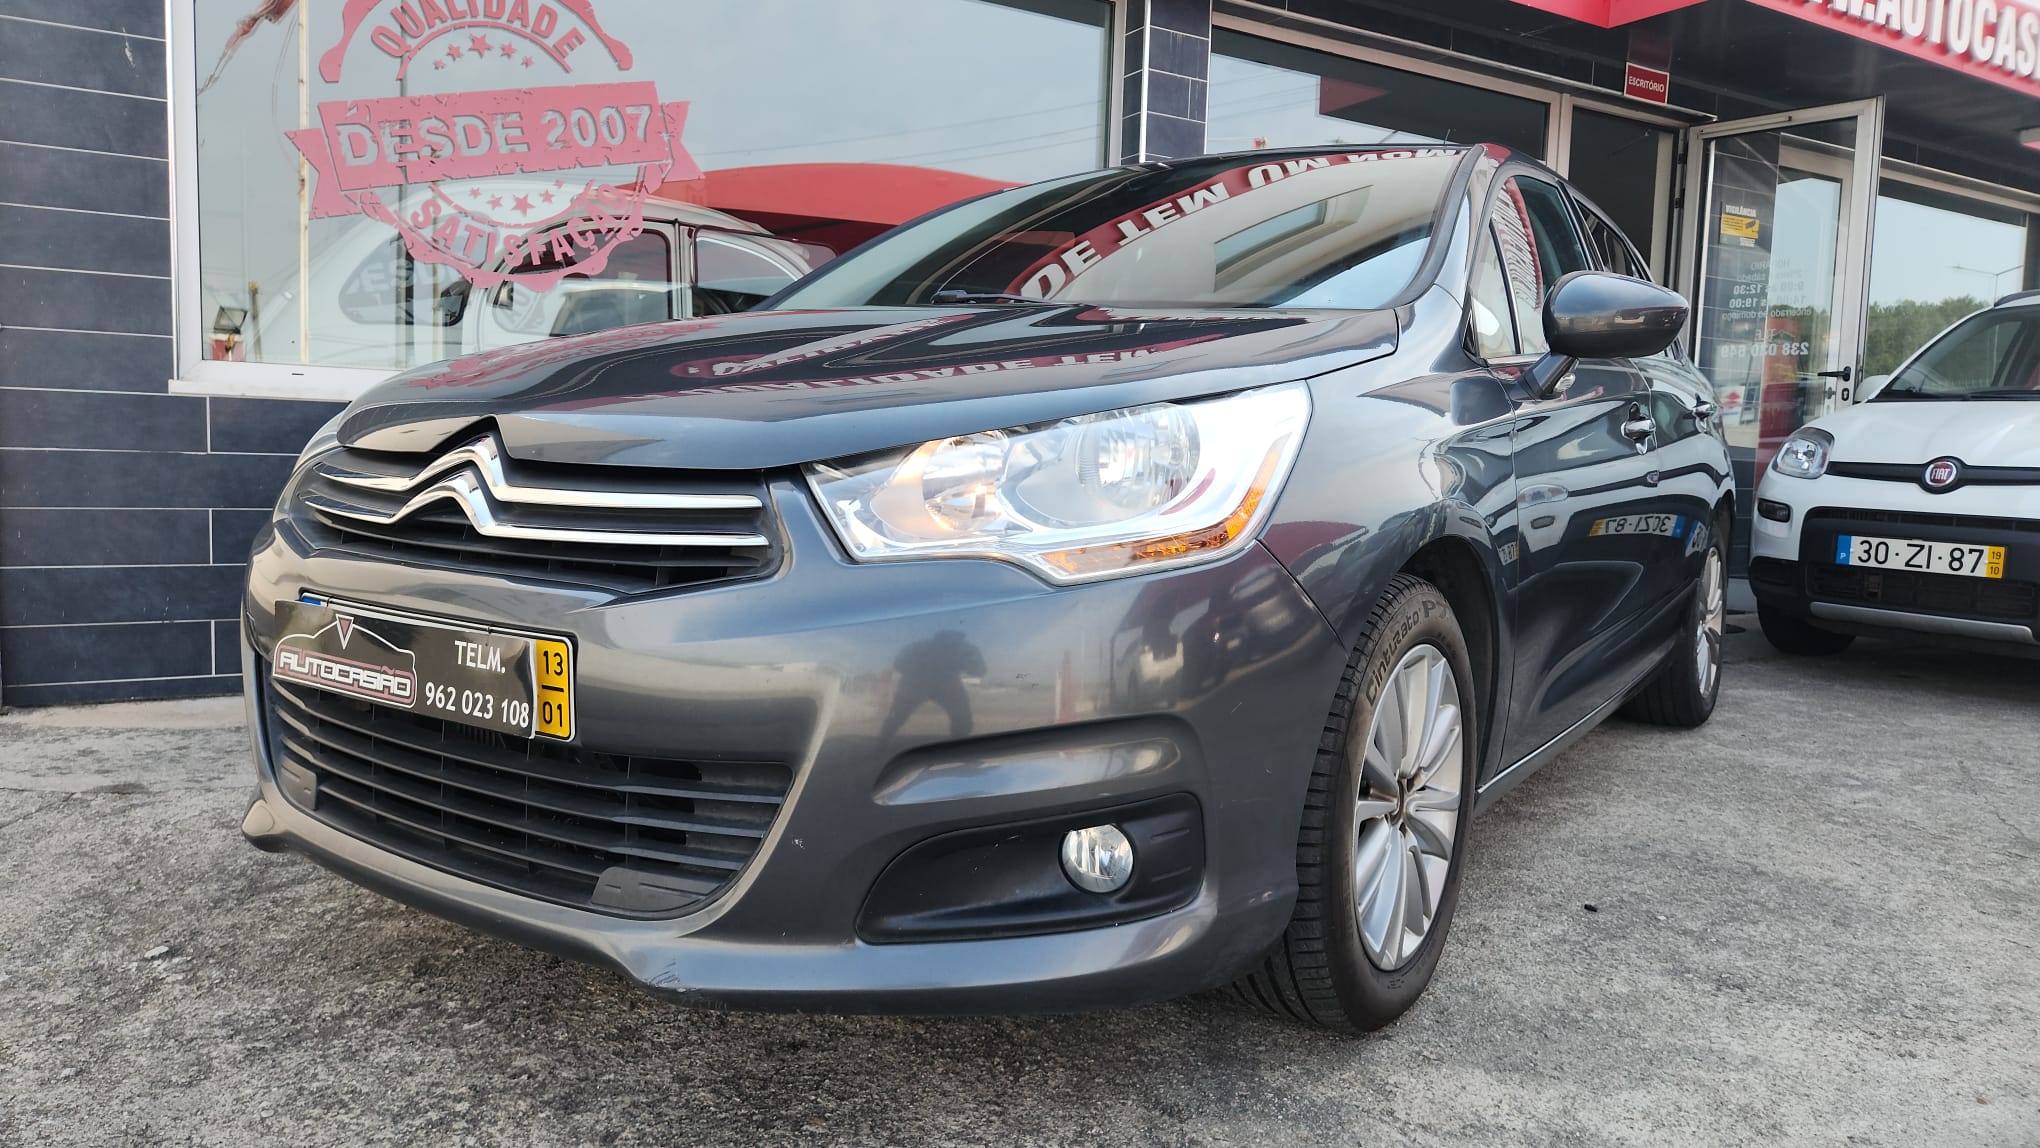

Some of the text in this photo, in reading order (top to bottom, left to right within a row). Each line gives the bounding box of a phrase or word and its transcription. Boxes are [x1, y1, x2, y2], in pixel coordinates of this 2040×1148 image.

[370, 0, 587, 58] QUALIDADE
[1628, 75, 1665, 93] ESCRITÓRIO
[336, 103, 653, 168] DESDE 2007
[1931, 466, 1951, 480] FIAT
[1991, 551, 2002, 561] 19
[1989, 566, 2000, 576] 10
[455, 640, 506, 674] TELM.
[542, 650, 565, 677] 13
[425, 681, 529, 728] 962 023 108
[542, 700, 564, 729] 01
